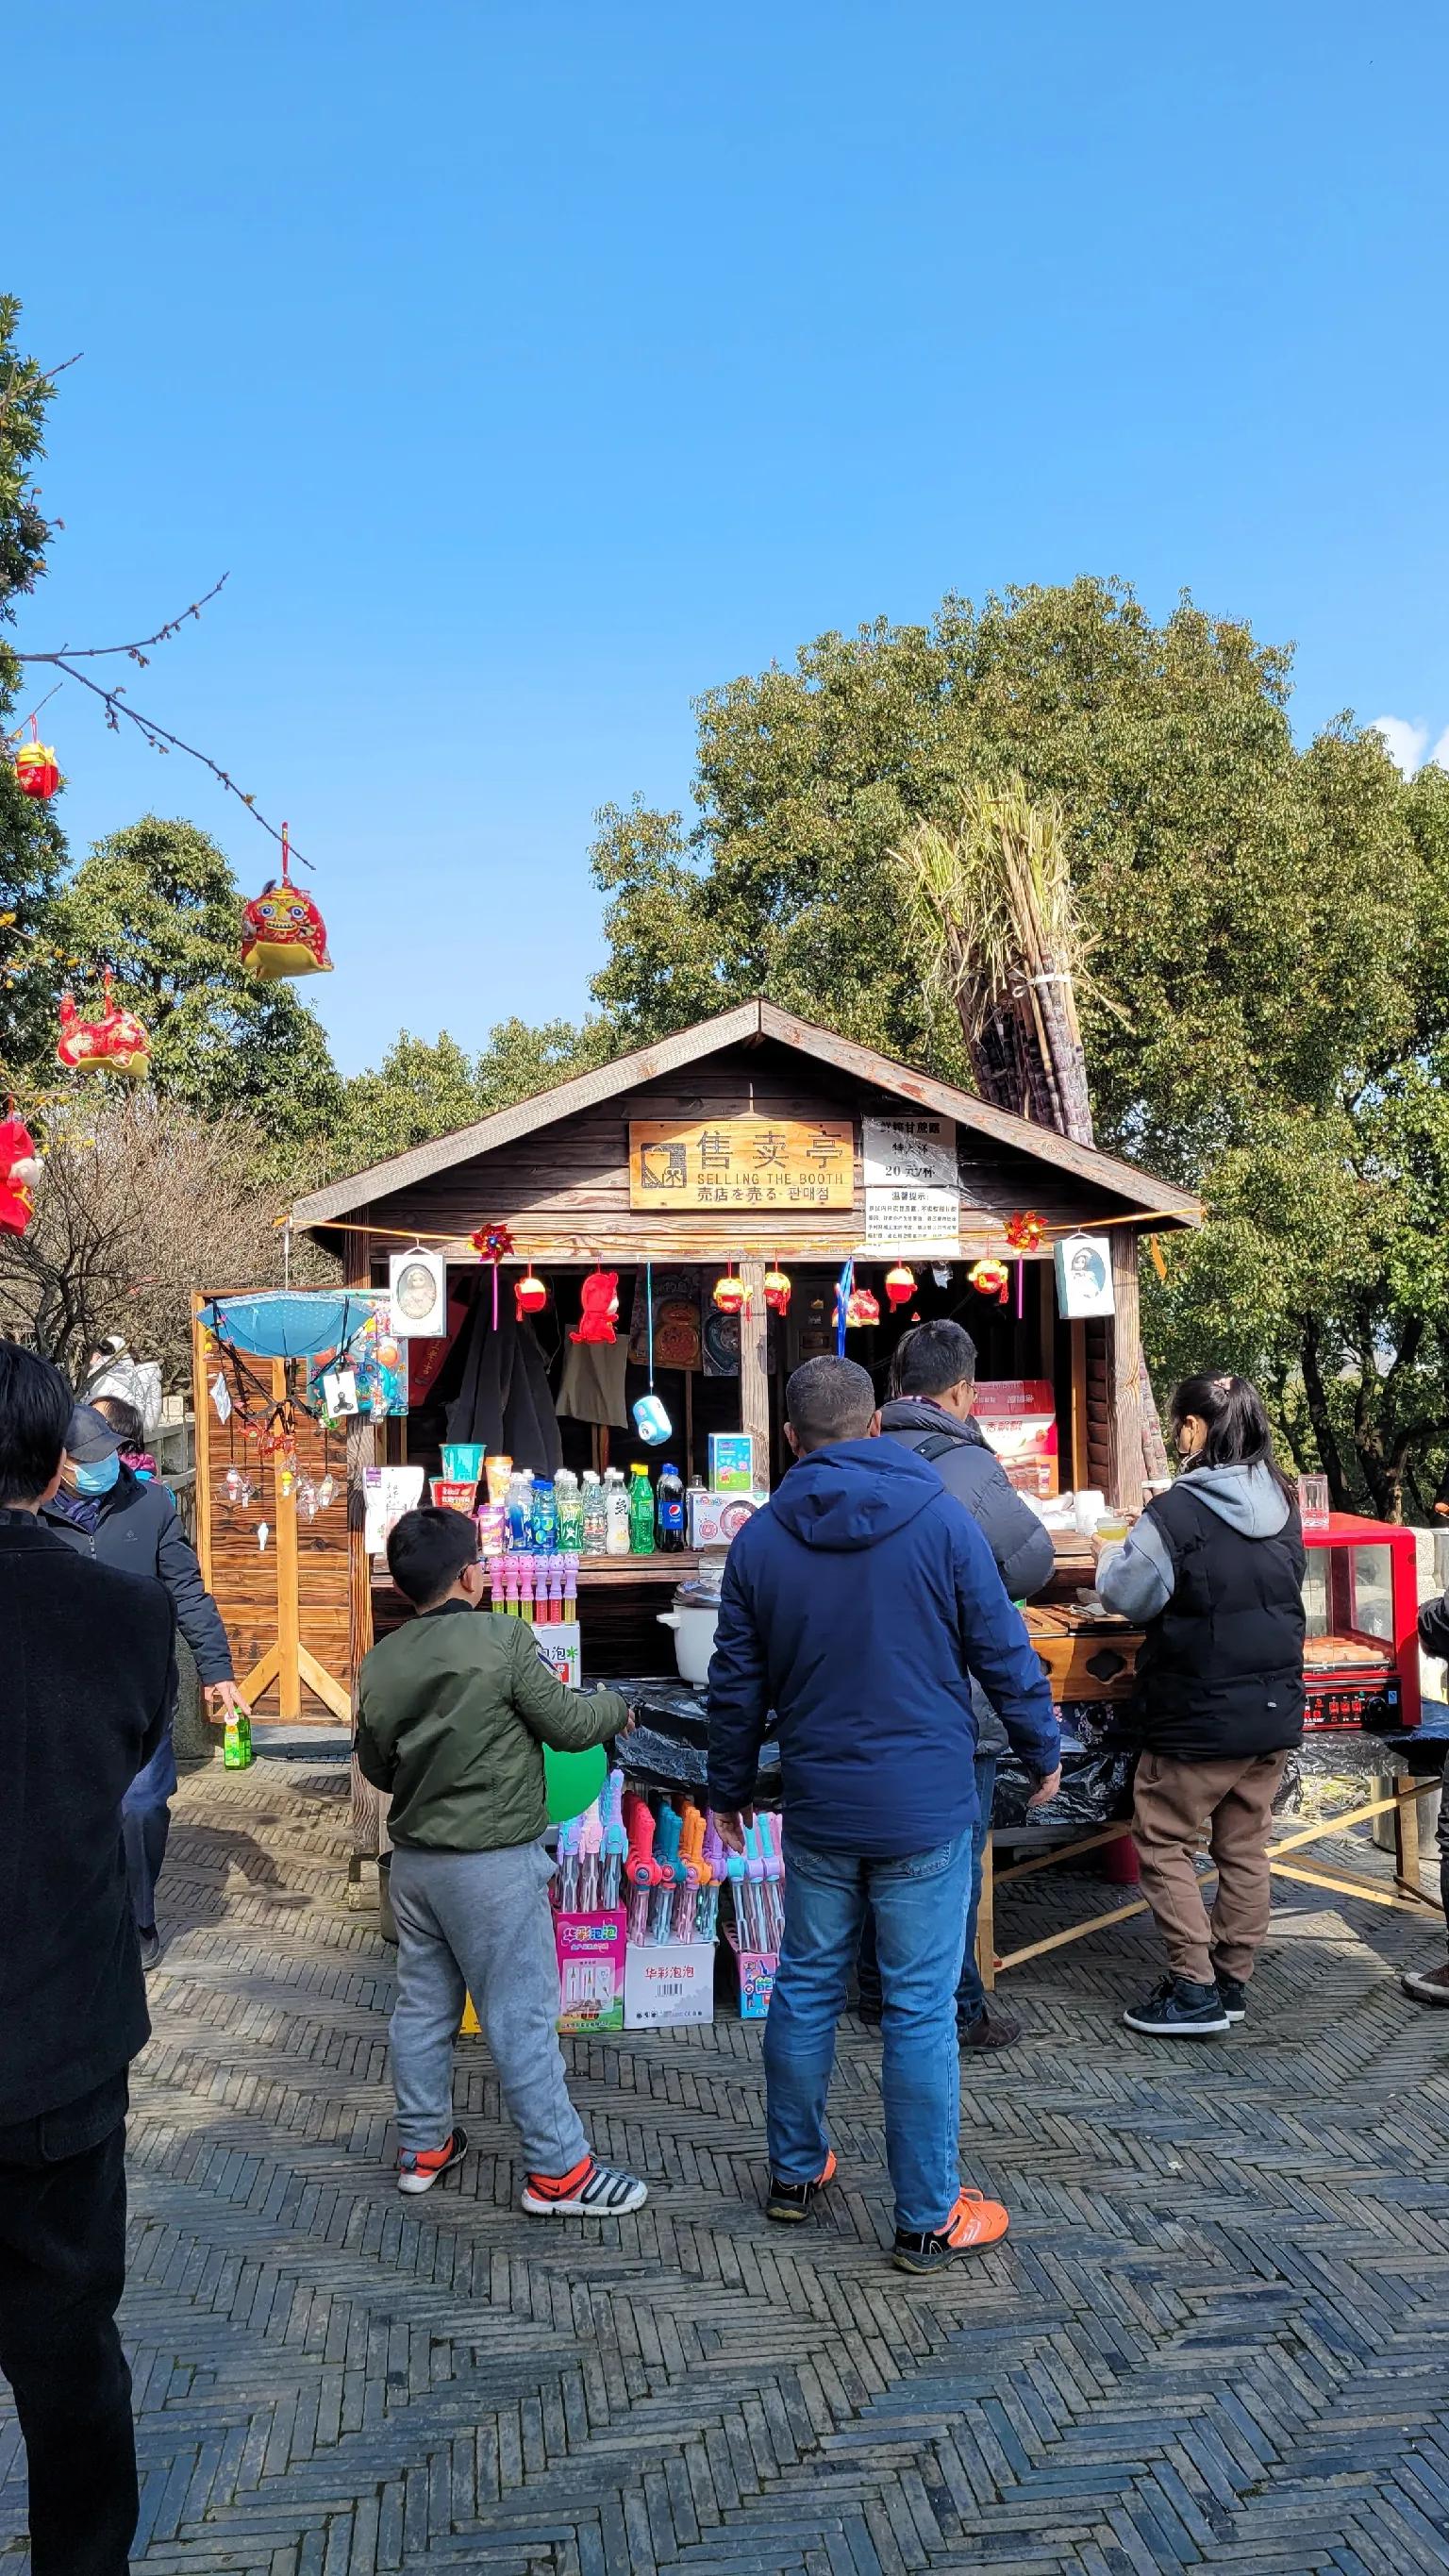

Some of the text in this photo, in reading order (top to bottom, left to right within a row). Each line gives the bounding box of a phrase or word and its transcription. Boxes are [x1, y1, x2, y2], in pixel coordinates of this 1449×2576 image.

[696, 1130, 842, 1170] 售卖亭
[697, 1173, 843, 1186] SELLING THE BOOTH
[563, 1925, 618, 1941] 华彩泡泡
[644, 1965, 694, 1980] 华彩泡泡
